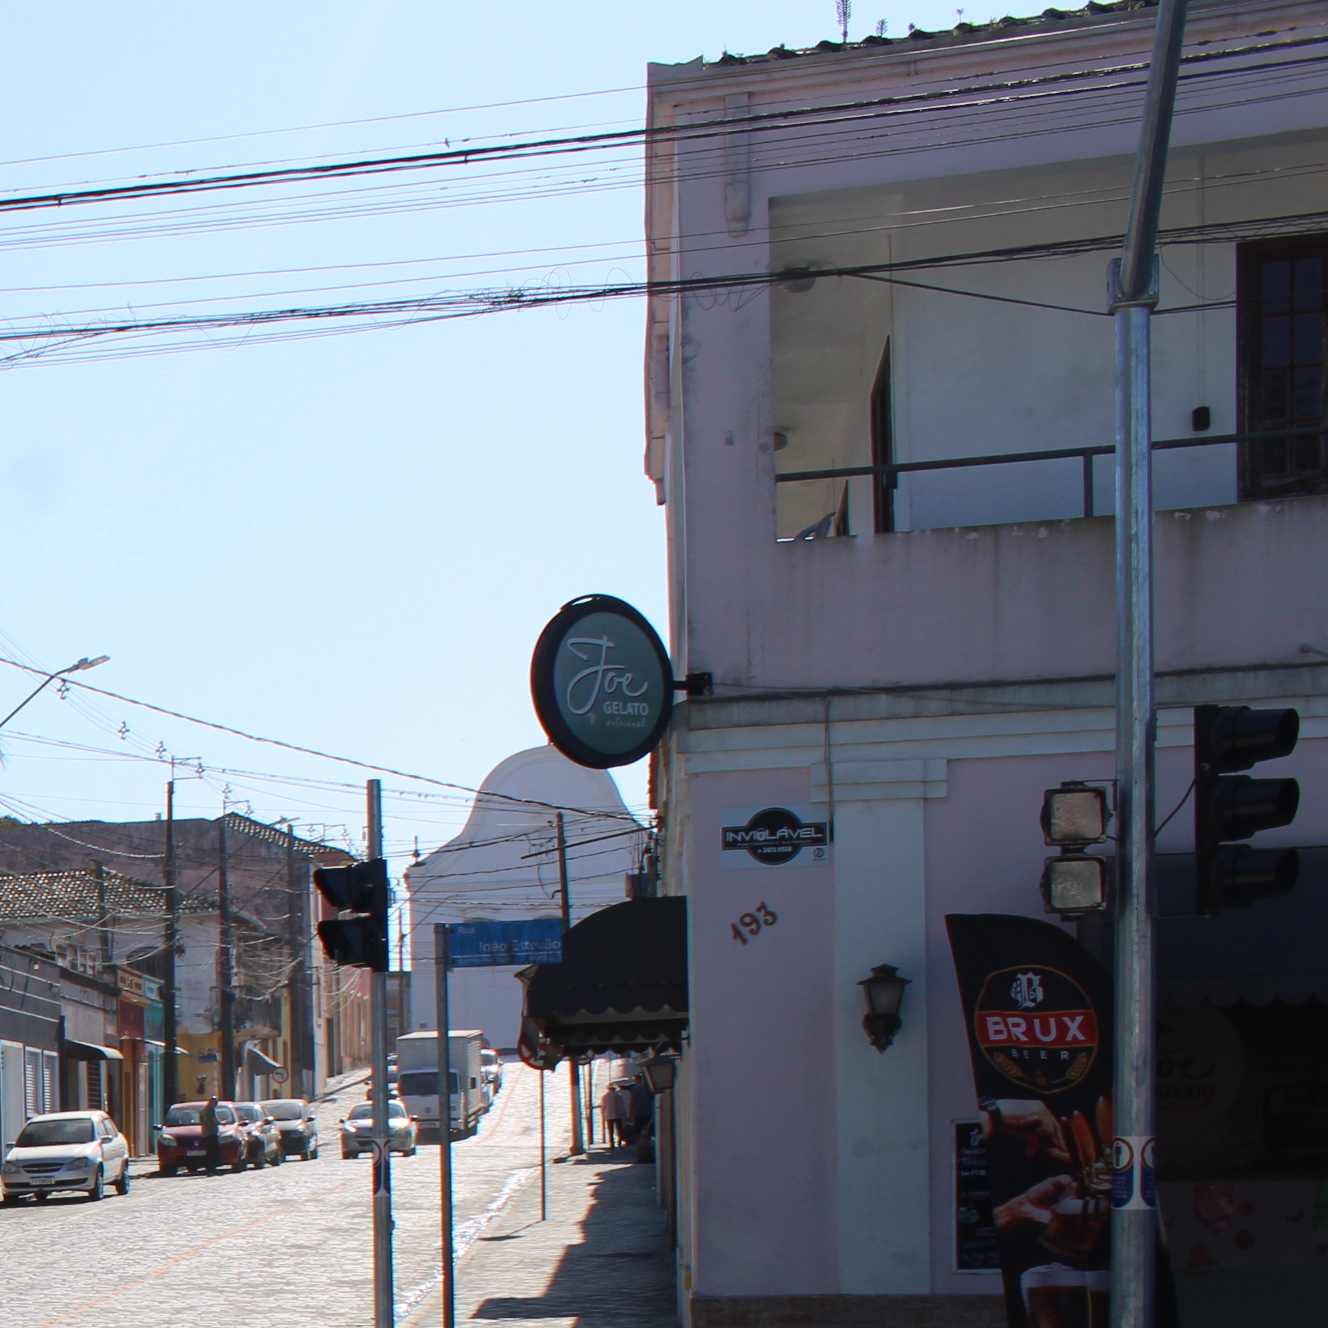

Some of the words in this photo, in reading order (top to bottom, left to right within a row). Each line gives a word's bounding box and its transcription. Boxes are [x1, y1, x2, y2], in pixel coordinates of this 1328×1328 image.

[566, 635, 649, 715] Joe
[603, 701, 649, 716] GELATO
[726, 826, 823, 842] INVIOLÁVEL
[457, 926, 476, 934] Rua
[731, 901, 778, 946] 193
[986, 1015, 1087, 1042] BRUX
[1011, 1049, 1070, 1060] BEER
